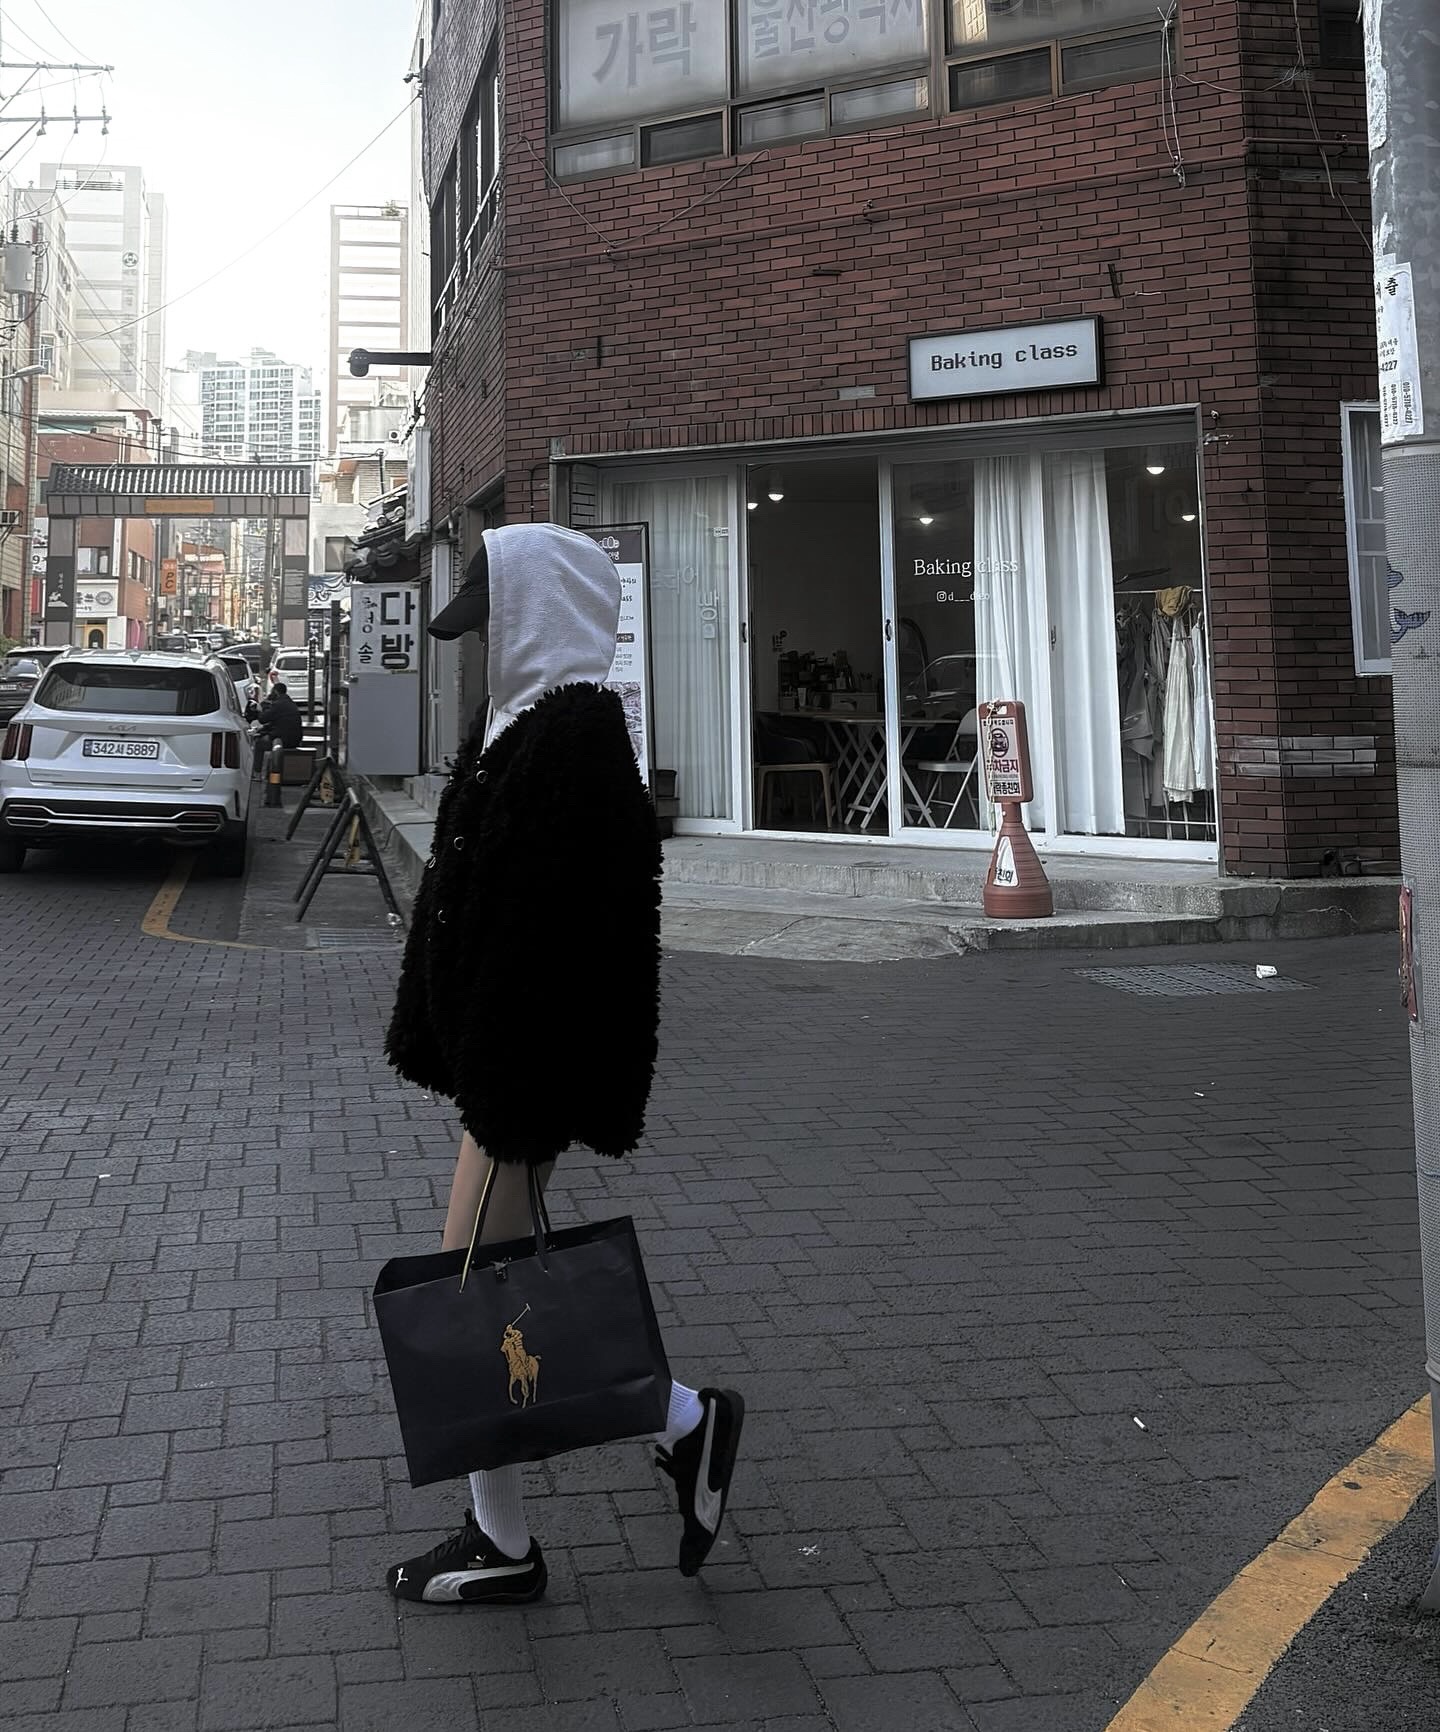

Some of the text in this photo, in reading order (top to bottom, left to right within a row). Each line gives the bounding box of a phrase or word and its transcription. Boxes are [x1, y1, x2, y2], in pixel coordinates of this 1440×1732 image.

[592, 1, 697, 87] 가락
[931, 344, 1078, 371] Baking class
[913, 556, 1020, 577] Baking class
[380, 591, 416, 670] 다방
